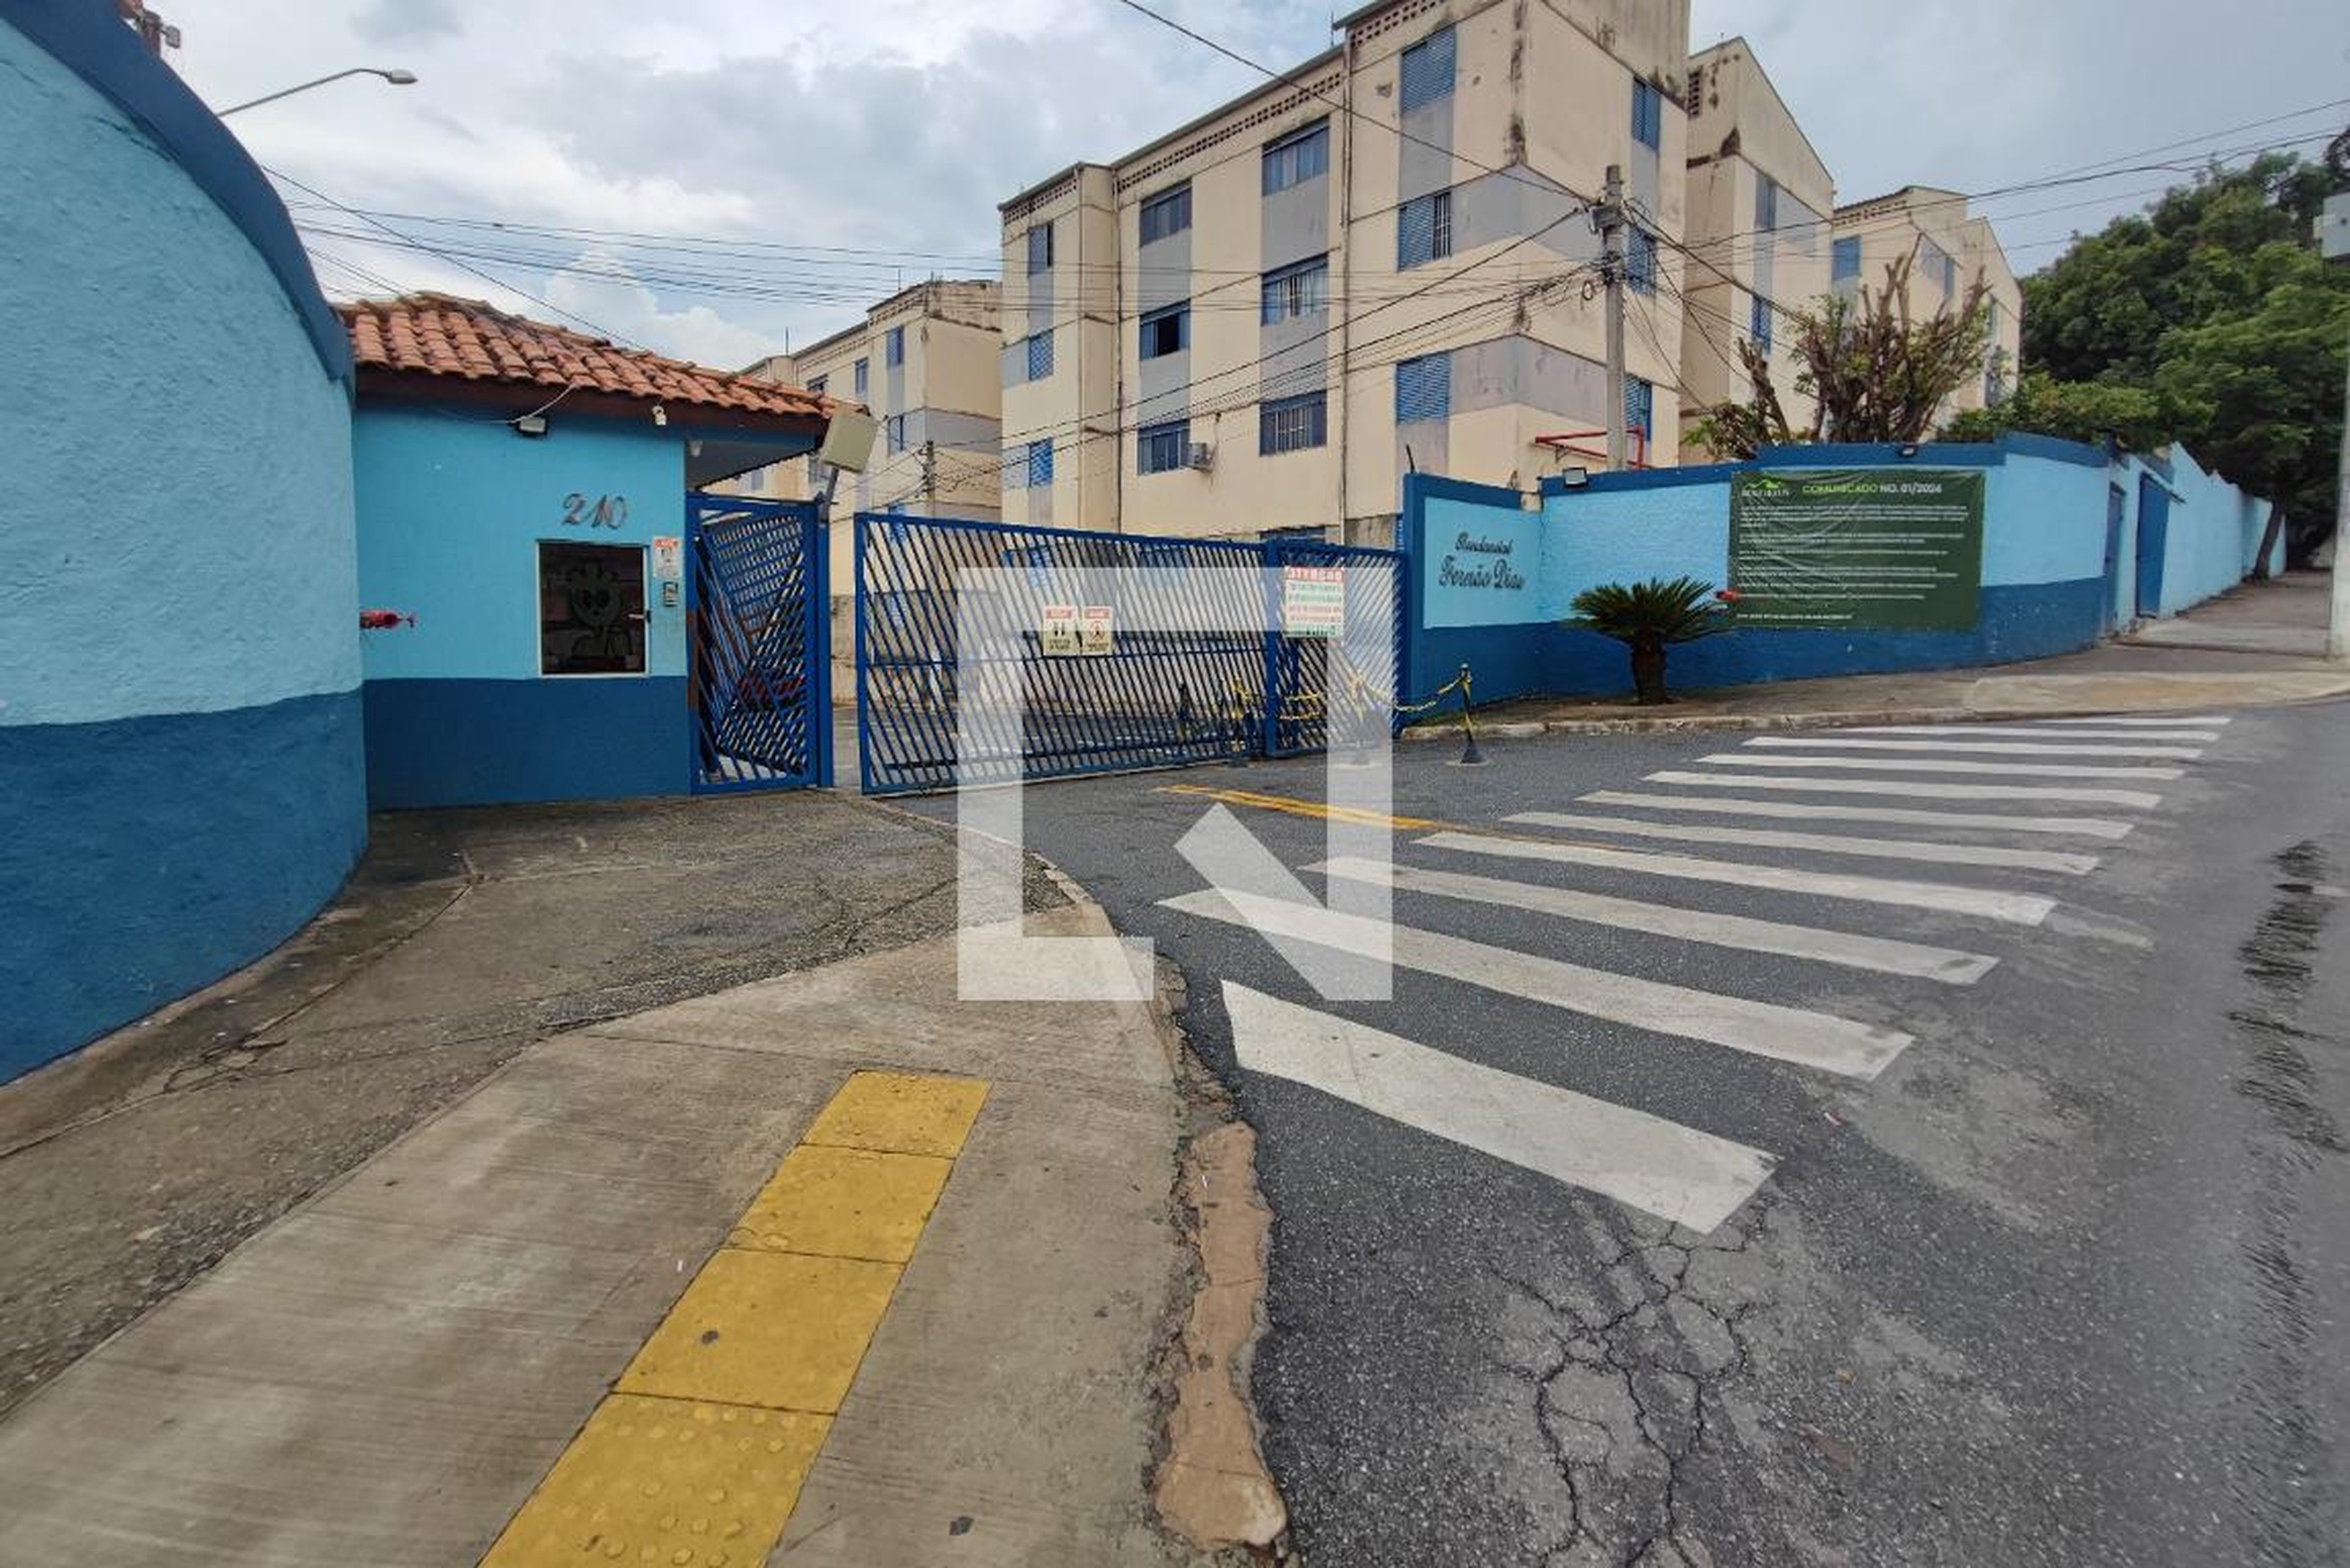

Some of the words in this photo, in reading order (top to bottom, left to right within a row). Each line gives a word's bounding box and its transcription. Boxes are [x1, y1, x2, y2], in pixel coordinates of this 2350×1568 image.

[1803, 482, 1879, 495] COMUNICADO
[562, 493, 627, 530] 210
[1493, 558, 1526, 590] Dias
